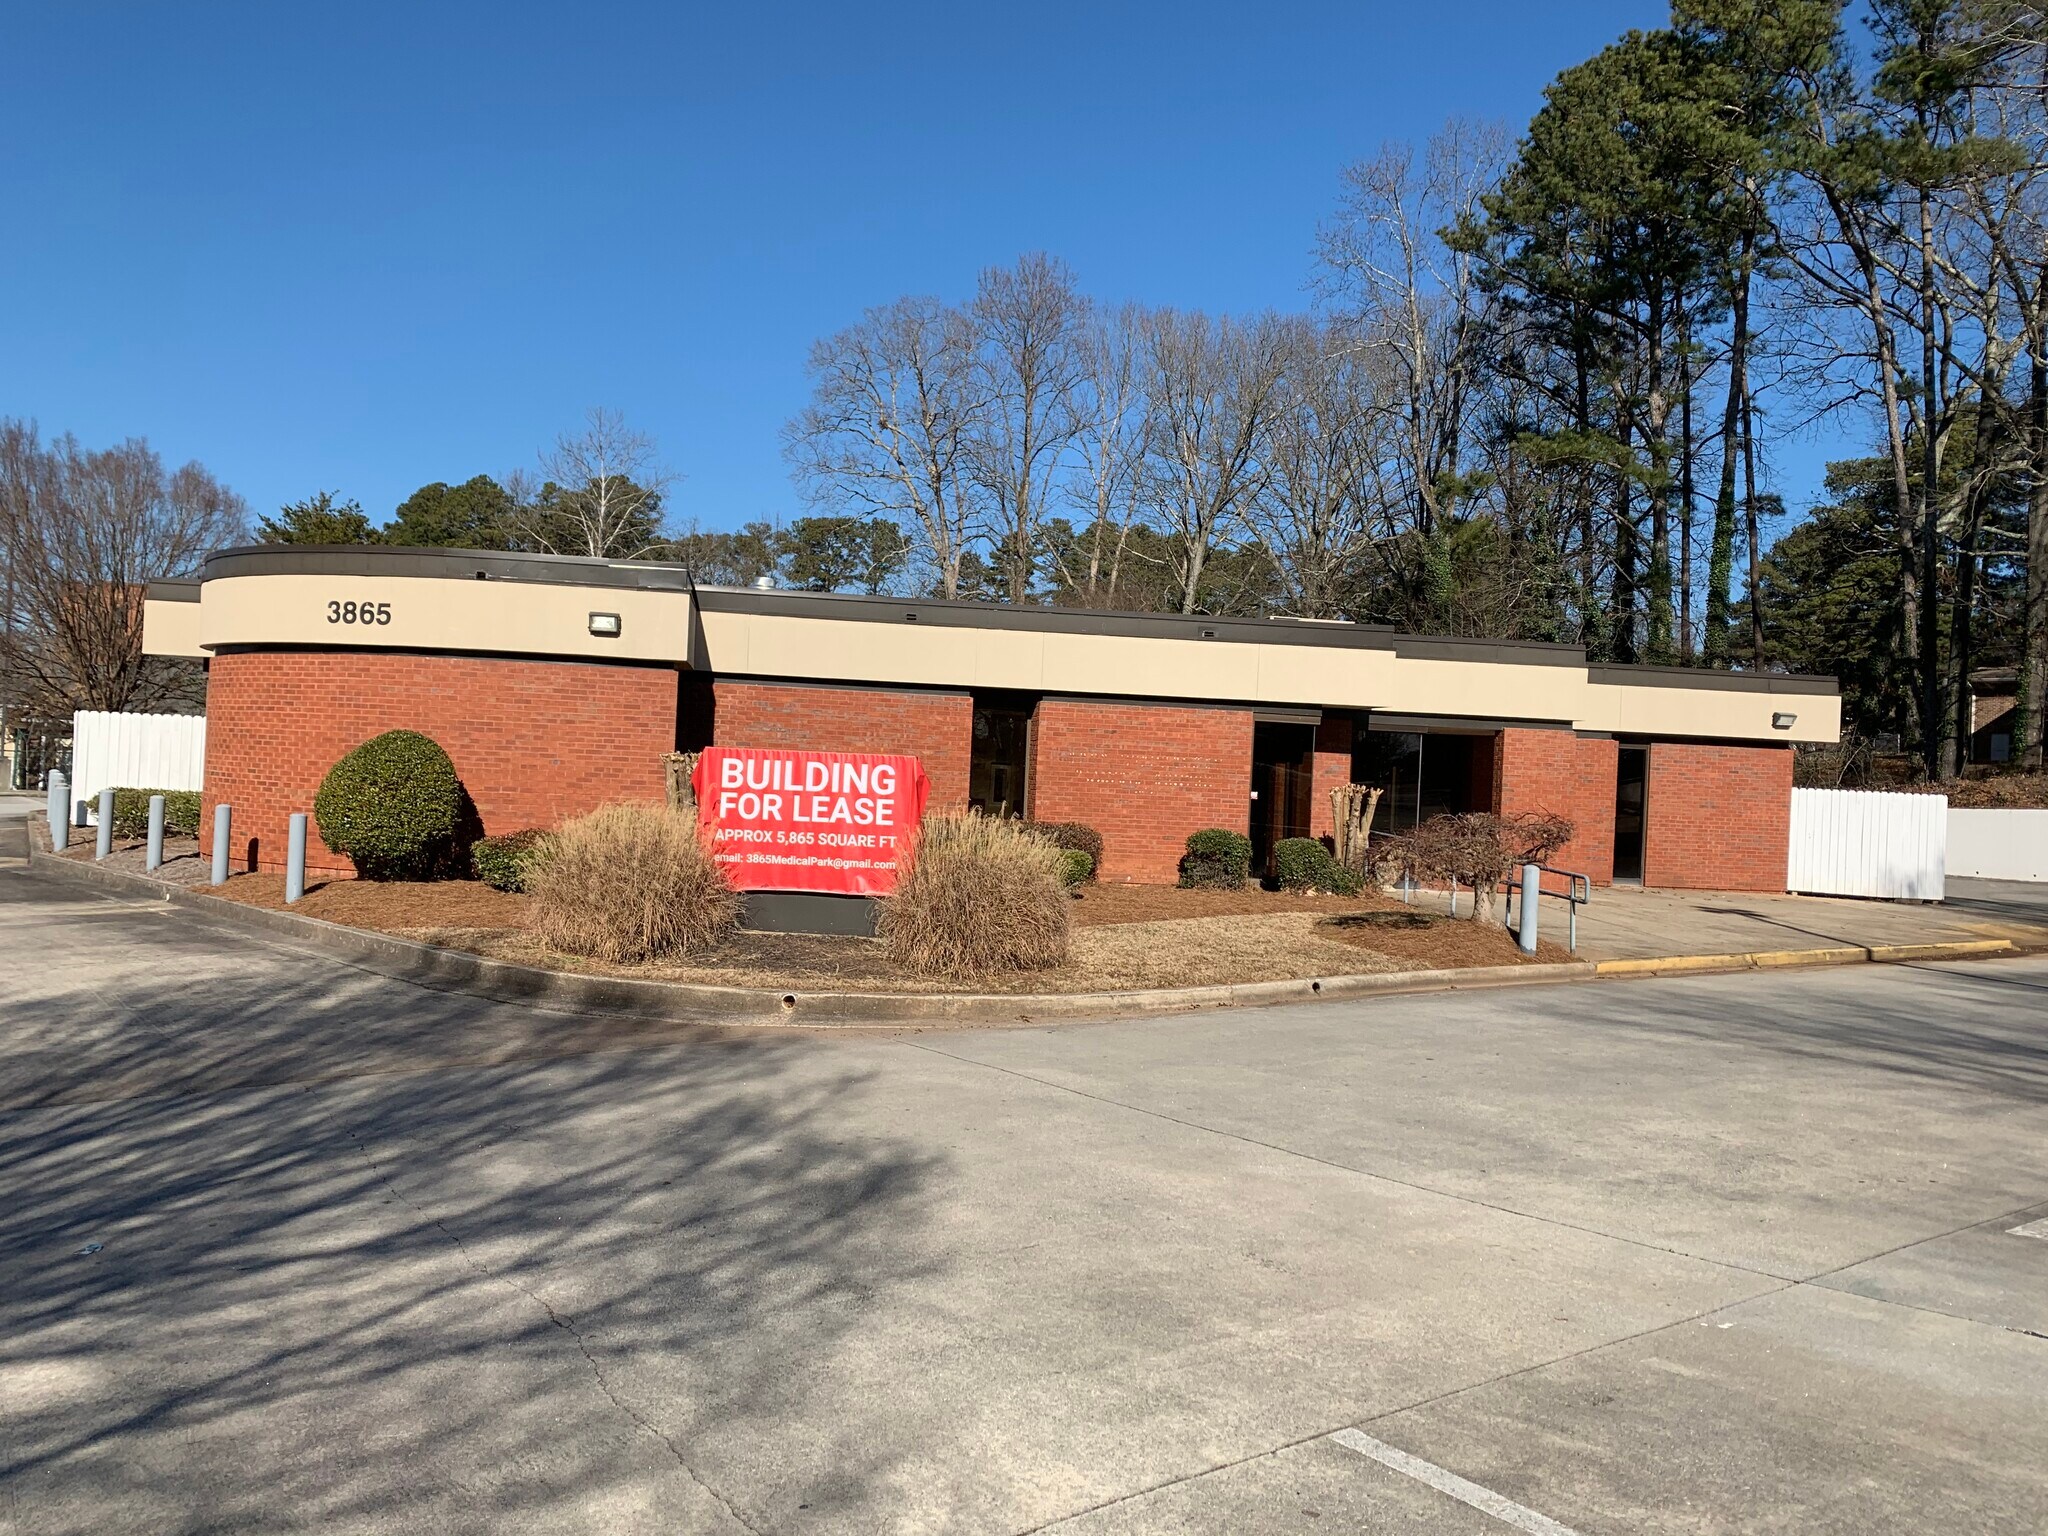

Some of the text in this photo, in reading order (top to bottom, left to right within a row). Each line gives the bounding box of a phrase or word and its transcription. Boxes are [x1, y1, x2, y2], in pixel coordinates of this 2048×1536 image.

[327, 600, 391, 626] 3865
[721, 757, 896, 796] BUILDING
[719, 791, 895, 826] FOR LEASE
[714, 828, 898, 849] APPROX 5,865 SQUARE FT
[714, 853, 896, 870] email: 3865MedicalPark@gmail.com
